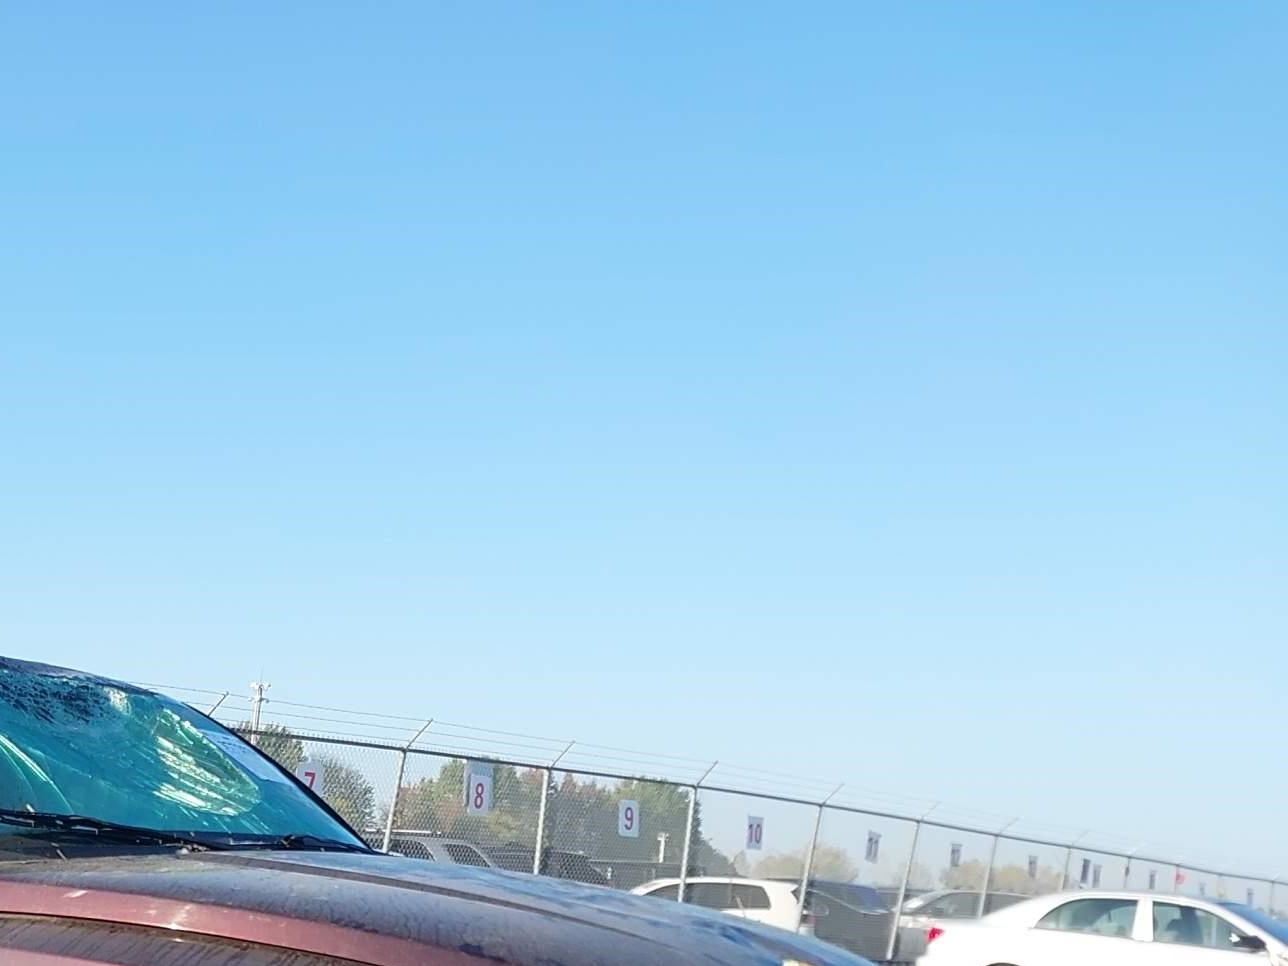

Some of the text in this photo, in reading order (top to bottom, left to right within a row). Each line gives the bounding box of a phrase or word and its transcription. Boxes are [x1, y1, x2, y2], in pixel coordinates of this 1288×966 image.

[304, 771, 316, 789] 7
[474, 782, 485, 809] 8
[624, 806, 634, 831] 9
[747, 823, 762, 844] 10
